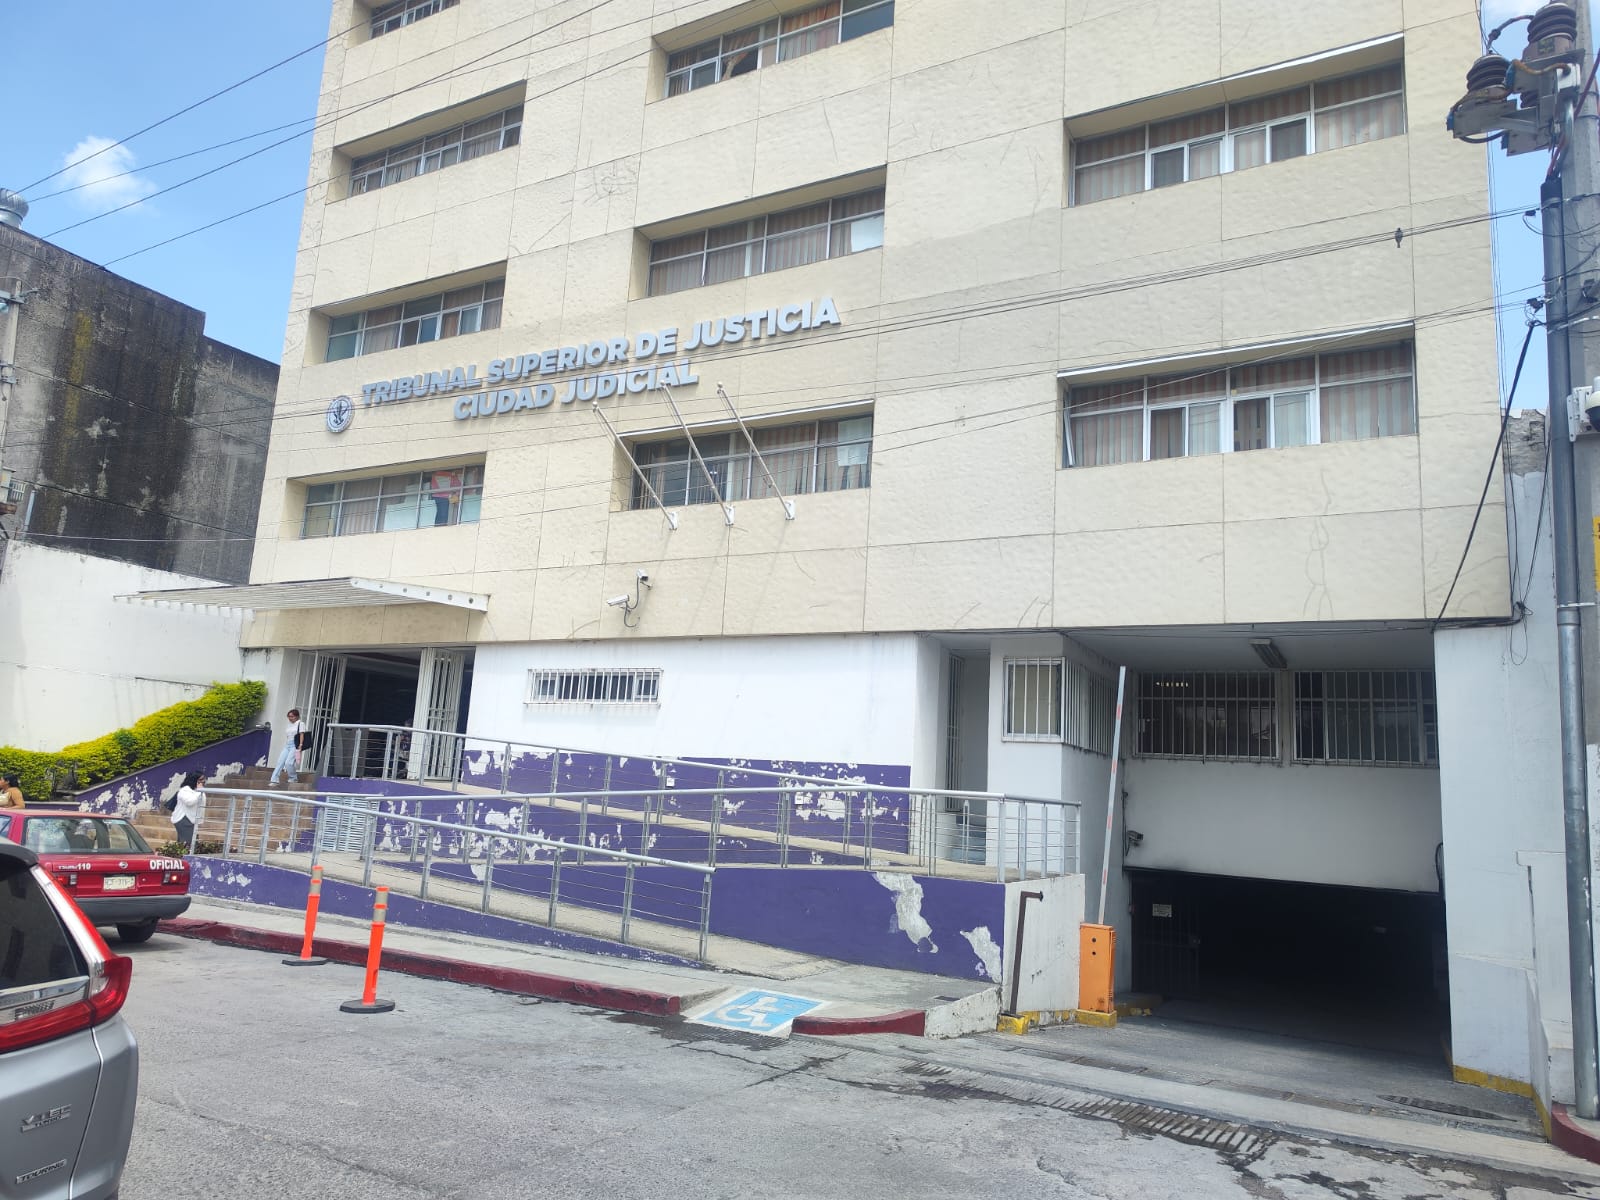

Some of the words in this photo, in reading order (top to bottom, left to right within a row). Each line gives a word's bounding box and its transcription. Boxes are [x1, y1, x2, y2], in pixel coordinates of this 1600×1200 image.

[362, 364, 481, 407] TRIBUNAL
[487, 338, 630, 384] SUPERIOR
[635, 327, 679, 357] DE
[683, 297, 841, 351] JUSTICIA
[454, 383, 556, 421] CIUDAD
[560, 358, 699, 405] JUDICIAL
[150, 859, 185, 870] OFICIAL
